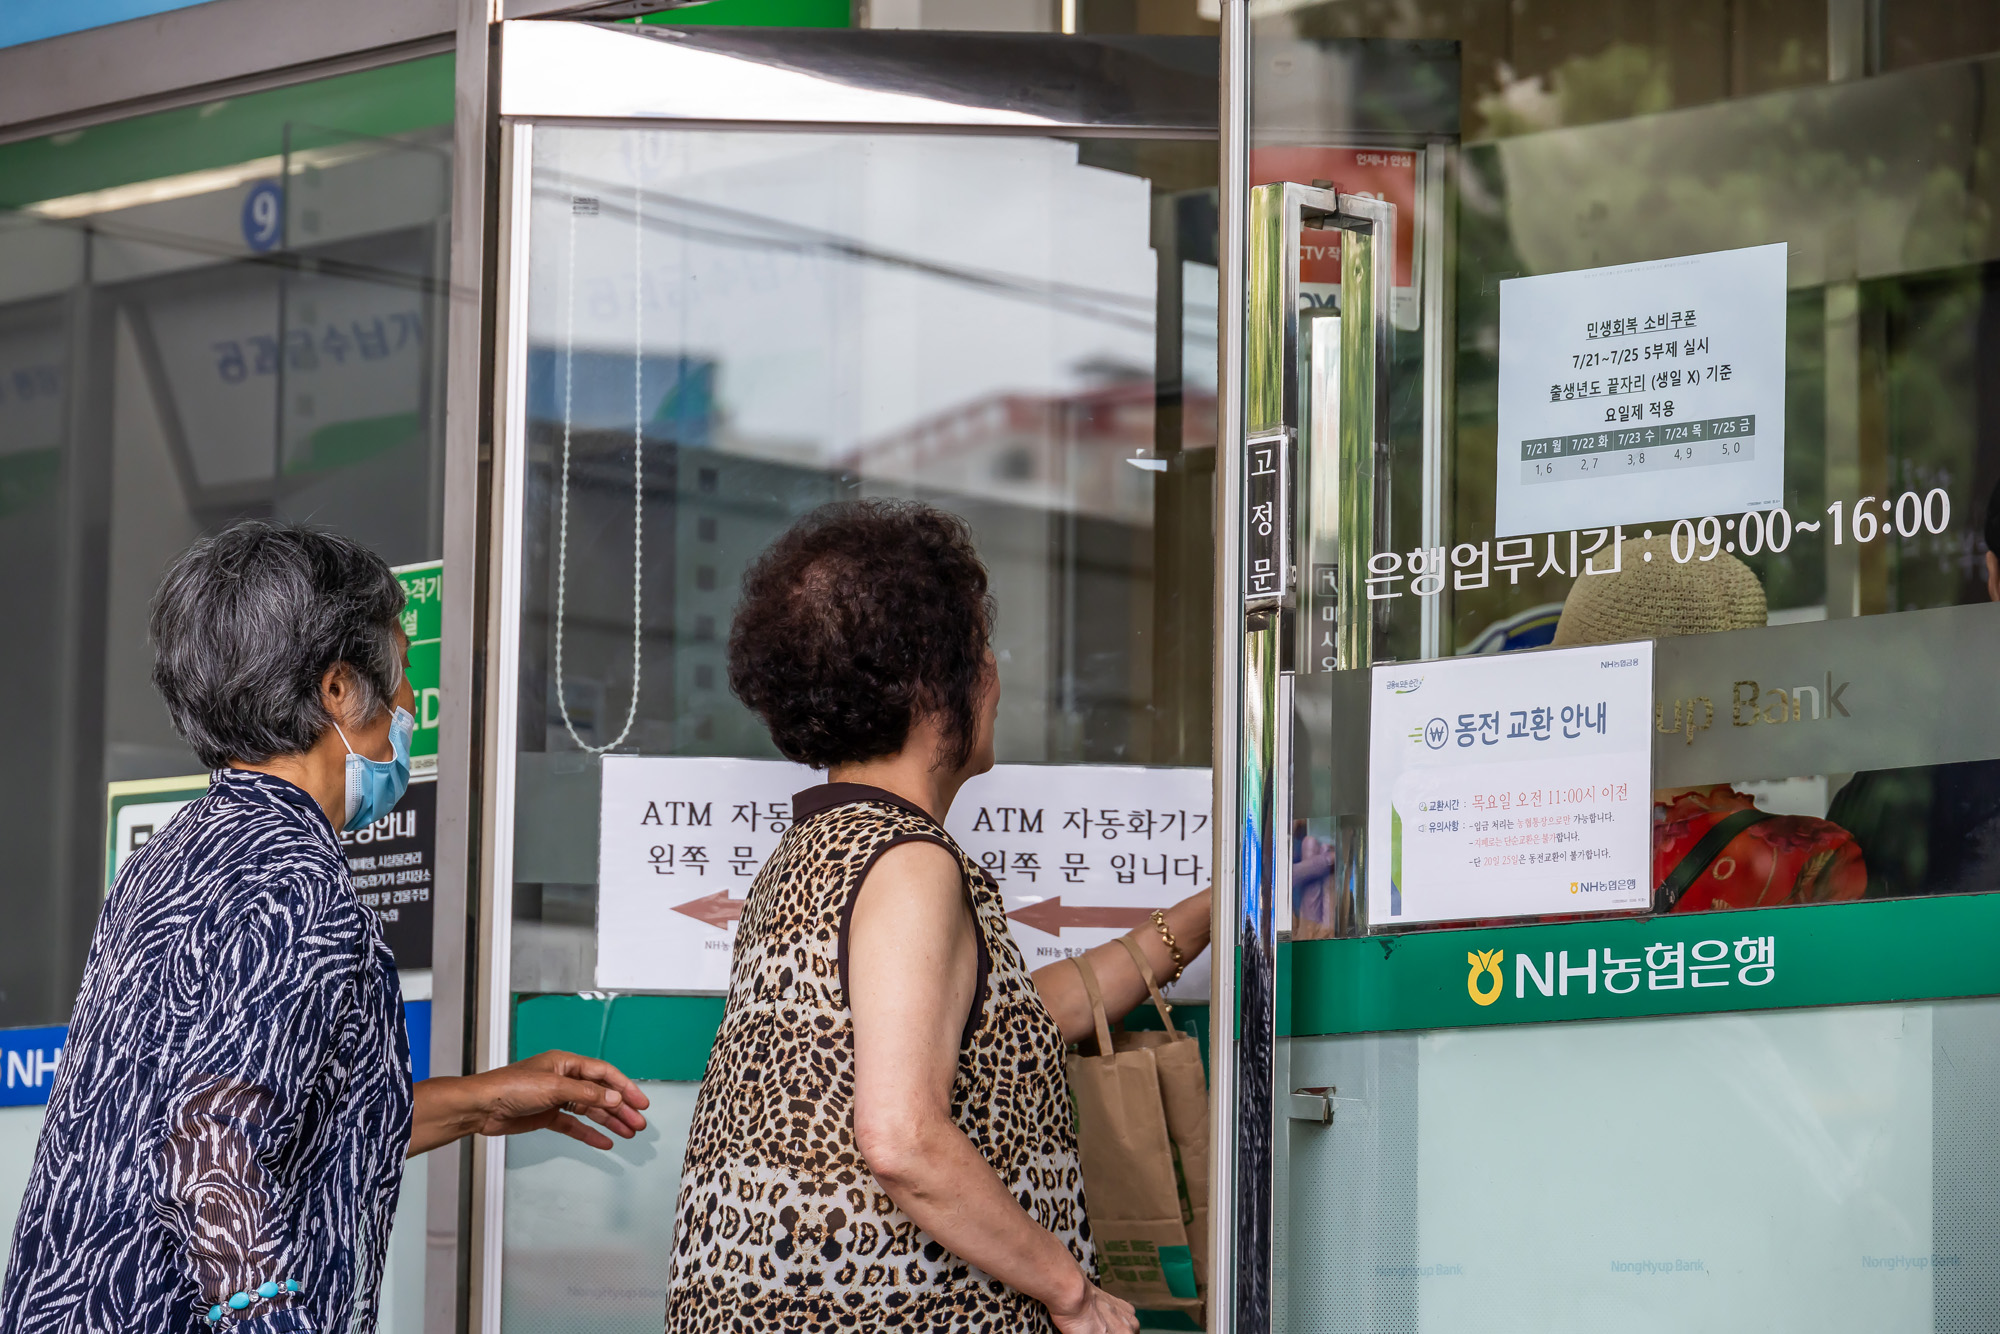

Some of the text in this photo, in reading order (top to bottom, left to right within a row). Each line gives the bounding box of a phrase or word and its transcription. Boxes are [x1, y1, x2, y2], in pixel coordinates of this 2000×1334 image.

[1356, 153, 1411, 168] 언제나 안심
[253, 191, 277, 242] 9
[1300, 246, 1325, 261] TV
[1586, 310, 1697, 339] 민생회복 소비쿠폰
[1572, 337, 1709, 369] 7/21~7/25 5부제 실시
[1550, 364, 1732, 401] 출생년도 끝자리 (생일 X) 기준
[1604, 400, 1675, 423] 요일제 적용
[1526, 418, 1750, 456] 7/21 월 7/22 화 7/23 수 7/24 목 7/25 금
[1250, 449, 1278, 592] 고정문
[1364, 524, 1626, 600] 은행업무시간
[1669, 488, 1951, 565] 09:00~16:00
[402, 609, 417, 637] 설
[1600, 658, 1639, 669] NH농협금융
[1733, 670, 1850, 727] Bank
[1455, 701, 1607, 748] 동전 교환 안내
[1429, 799, 1459, 811] 교환시간
[1472, 791, 1511, 811] 목요일
[1516, 789, 1542, 808] 오전
[1548, 785, 1595, 805] 11:00시
[1602, 783, 1627, 802] 이전
[640, 800, 713, 827] ATM
[971, 806, 1044, 833] ATM
[1429, 820, 1459, 833] 유의사항
[1492, 819, 1514, 830] 처리는
[1517, 814, 1571, 828] 농협통장으로만
[1573, 811, 1615, 825] 가능합니다.
[1504, 834, 1540, 847] 단순교환은
[1541, 830, 1580, 845] 불가합니다.
[648, 844, 759, 876] 왼쪽 문
[981, 850, 1212, 886] 왼쪽 문 입니다.
[1484, 855, 1500, 867] 20일
[1502, 853, 1526, 866] 25일은
[1528, 850, 1567, 865] 동전교환이
[1569, 847, 1611, 862] 불가합니다.
[1580, 878, 1636, 893] NH농협은행
[704, 940, 734, 952] NH농
[1516, 936, 1775, 998] NH농협은행
[1610, 1258, 1705, 1275] NongHyup Bank
[1861, 1255, 1929, 1271] NongHyup
